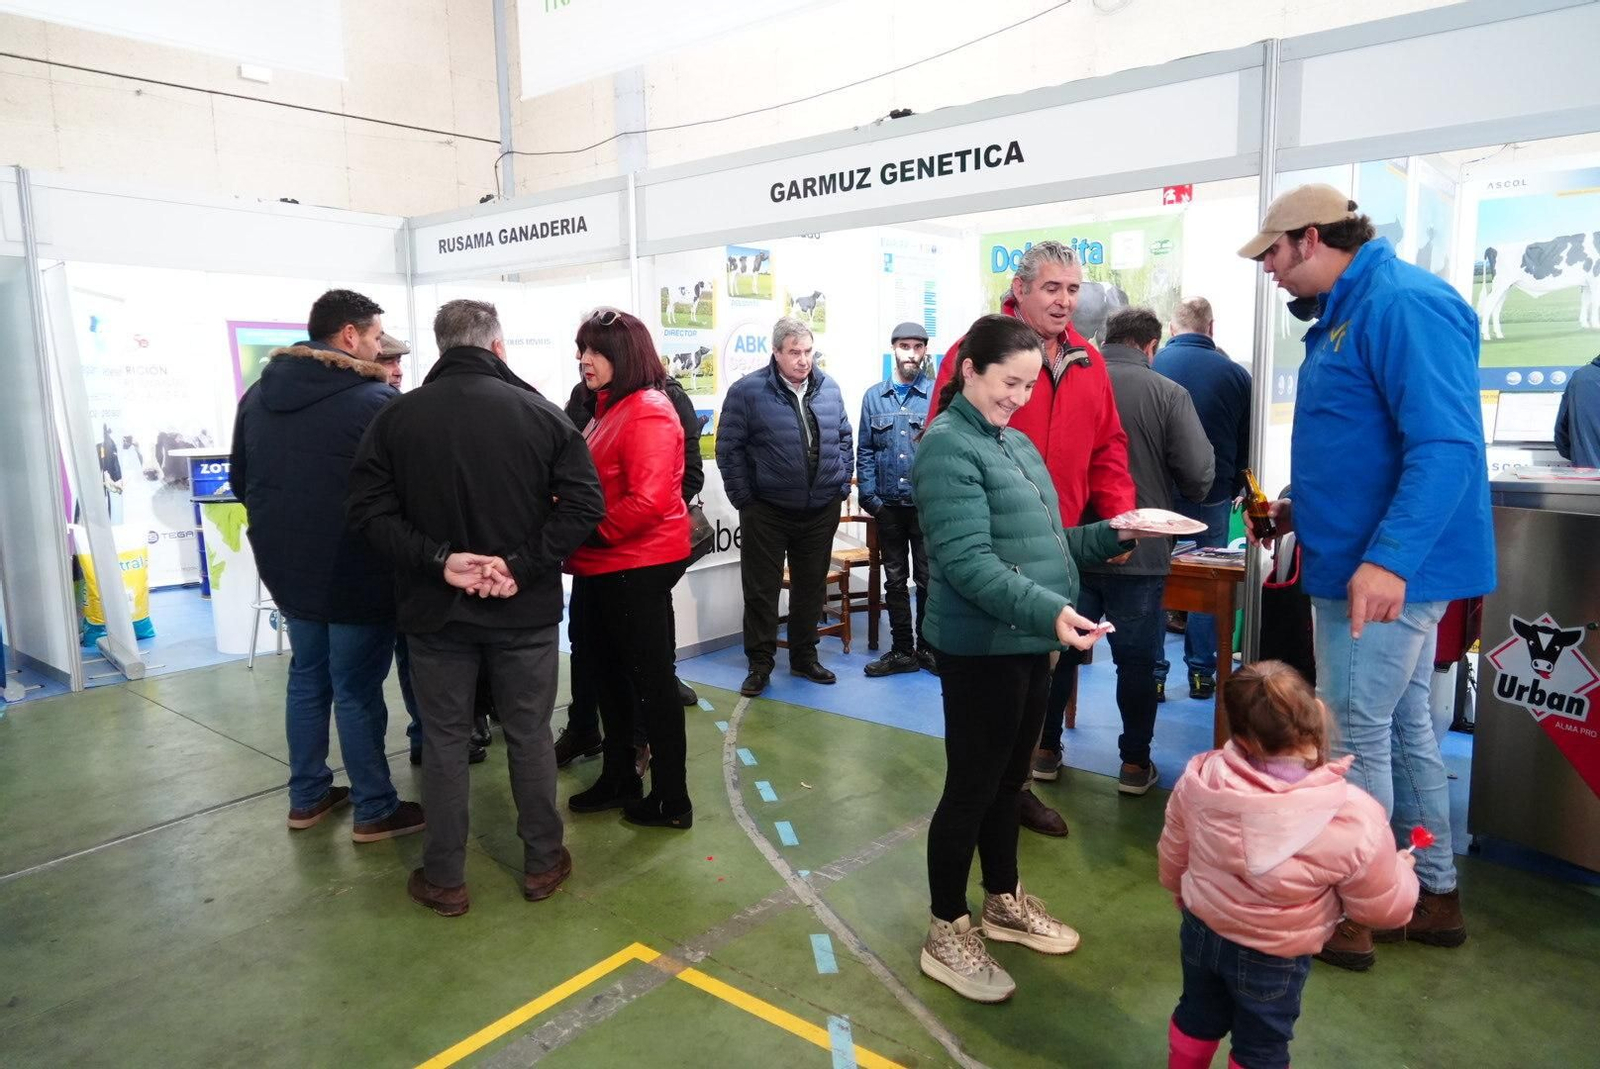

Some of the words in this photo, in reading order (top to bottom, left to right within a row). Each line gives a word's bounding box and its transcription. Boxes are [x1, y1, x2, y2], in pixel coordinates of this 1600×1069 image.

[770, 166, 872, 203] GARMUZ
[880, 140, 1025, 186] GENETICA
[1487, 178, 1528, 189] ASCOL
[438, 231, 494, 254] RUSAMA
[499, 216, 588, 245] GANADERIA
[990, 237, 1104, 274] Doita
[734, 334, 768, 354] ABK
[200, 463, 232, 475] ZOT
[161, 530, 195, 540] TEGA
[118, 556, 144, 572] tral
[1497, 673, 1586, 717] Urban
[1555, 721, 1579, 733] ALMA
[1579, 727, 1598, 738] PRO
